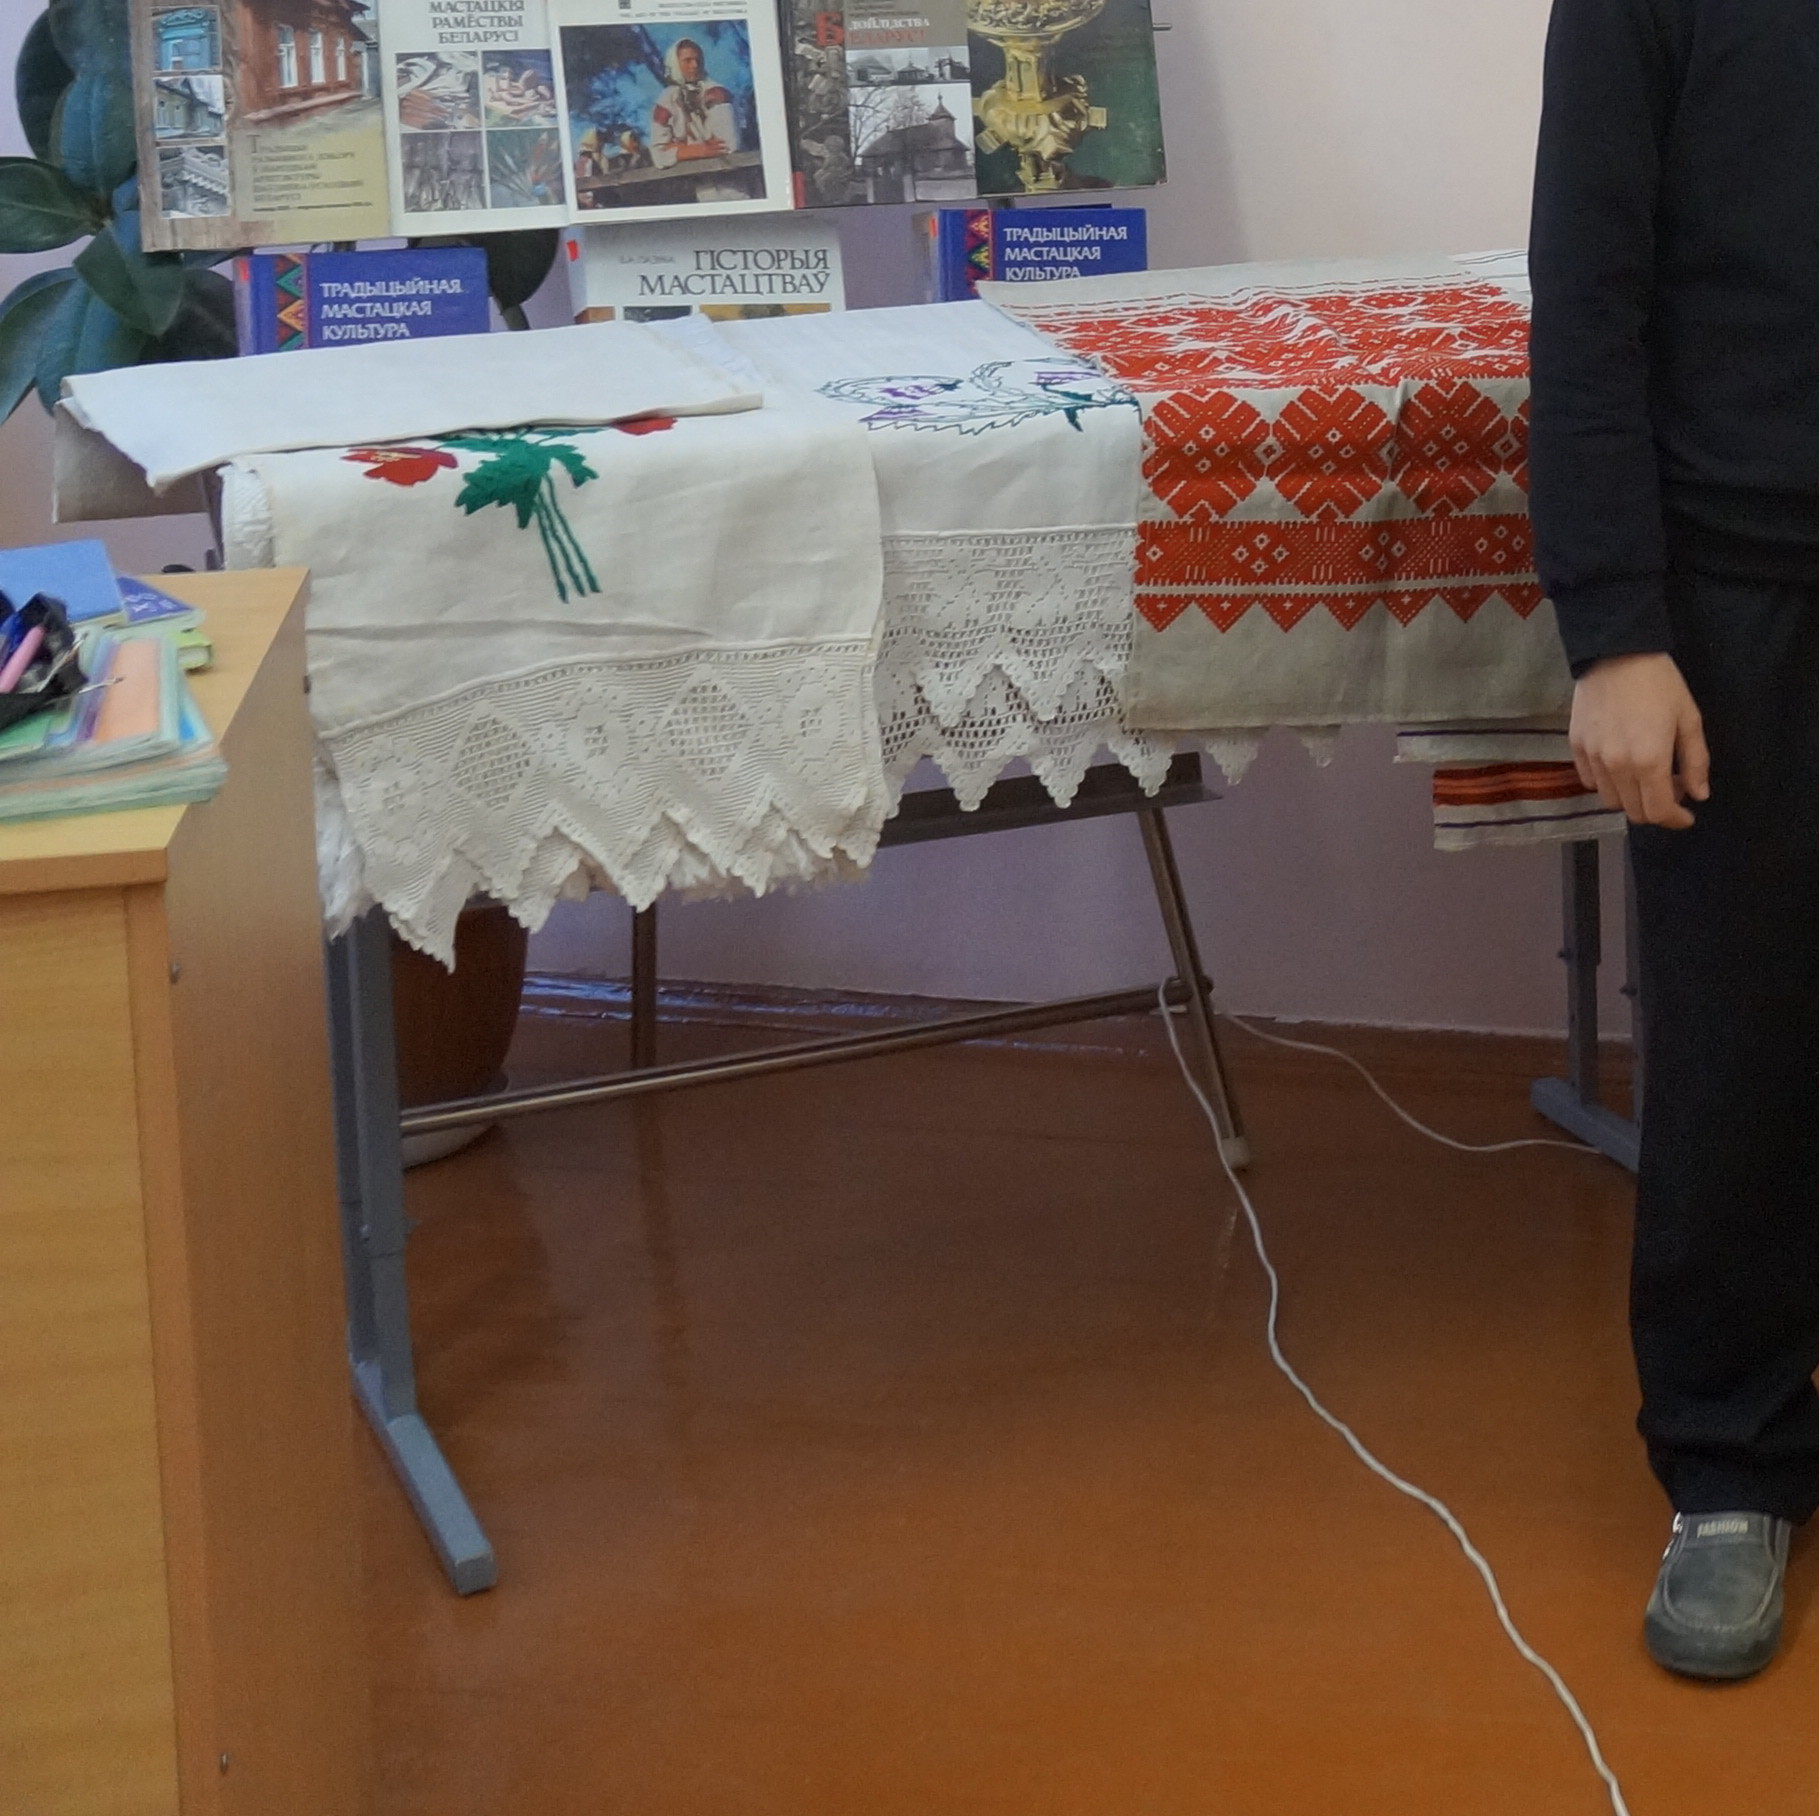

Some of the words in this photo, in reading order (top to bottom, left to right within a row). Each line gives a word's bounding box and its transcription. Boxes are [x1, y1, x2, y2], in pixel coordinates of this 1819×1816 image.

[428, 0, 525, 14] МАСТАЦКІЯ
[432, 13, 524, 29] РАМЁСТВЫ
[438, 30, 519, 44] БЕЛАРУСІ
[1003, 224, 1128, 243] ТРАДЫЦЫЙНАЯ
[693, 249, 831, 271] ГІСТОРЫЯ
[1004, 246, 1102, 263] МАСТАЦКАЯ
[1005, 266, 1082, 281] КУЛЬТУРА
[319, 277, 463, 299] ТРАДЫЦЫЙНАЯ
[638, 271, 831, 297] МАСТАЦТВАЎ
[320, 300, 432, 320] МАСТАЦКАЯ
[322, 322, 411, 341] КУЛЬТУРА
